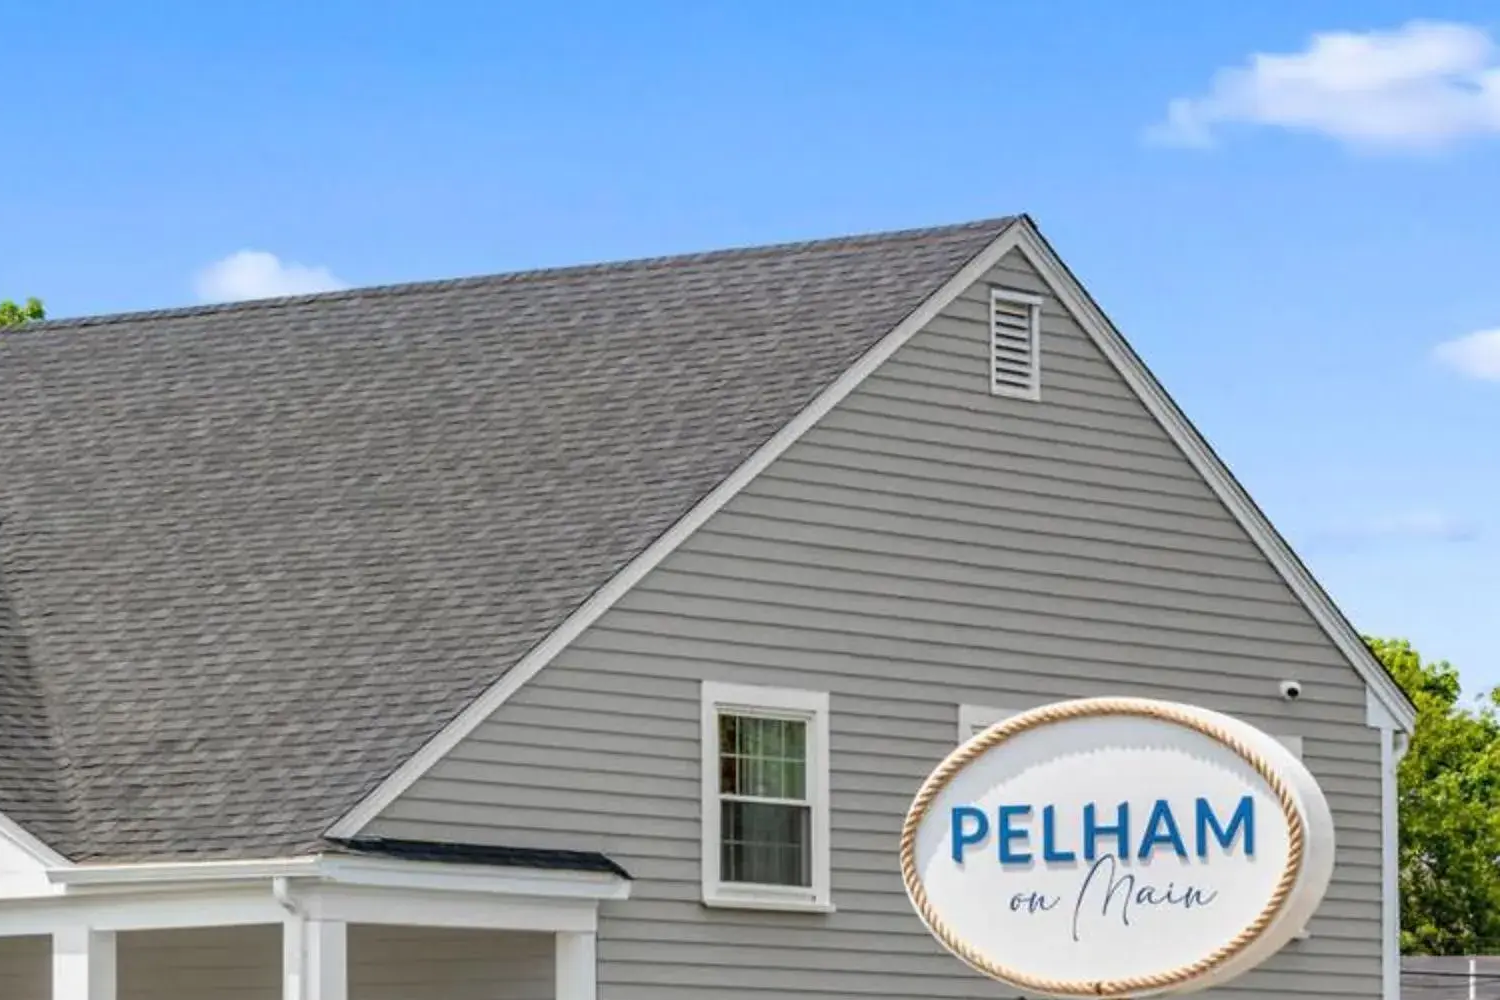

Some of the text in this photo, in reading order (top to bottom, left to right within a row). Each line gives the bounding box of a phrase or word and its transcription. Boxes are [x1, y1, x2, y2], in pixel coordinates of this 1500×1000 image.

[950, 795, 1256, 865] PELHAM
[1008, 852, 1219, 942] on Main
